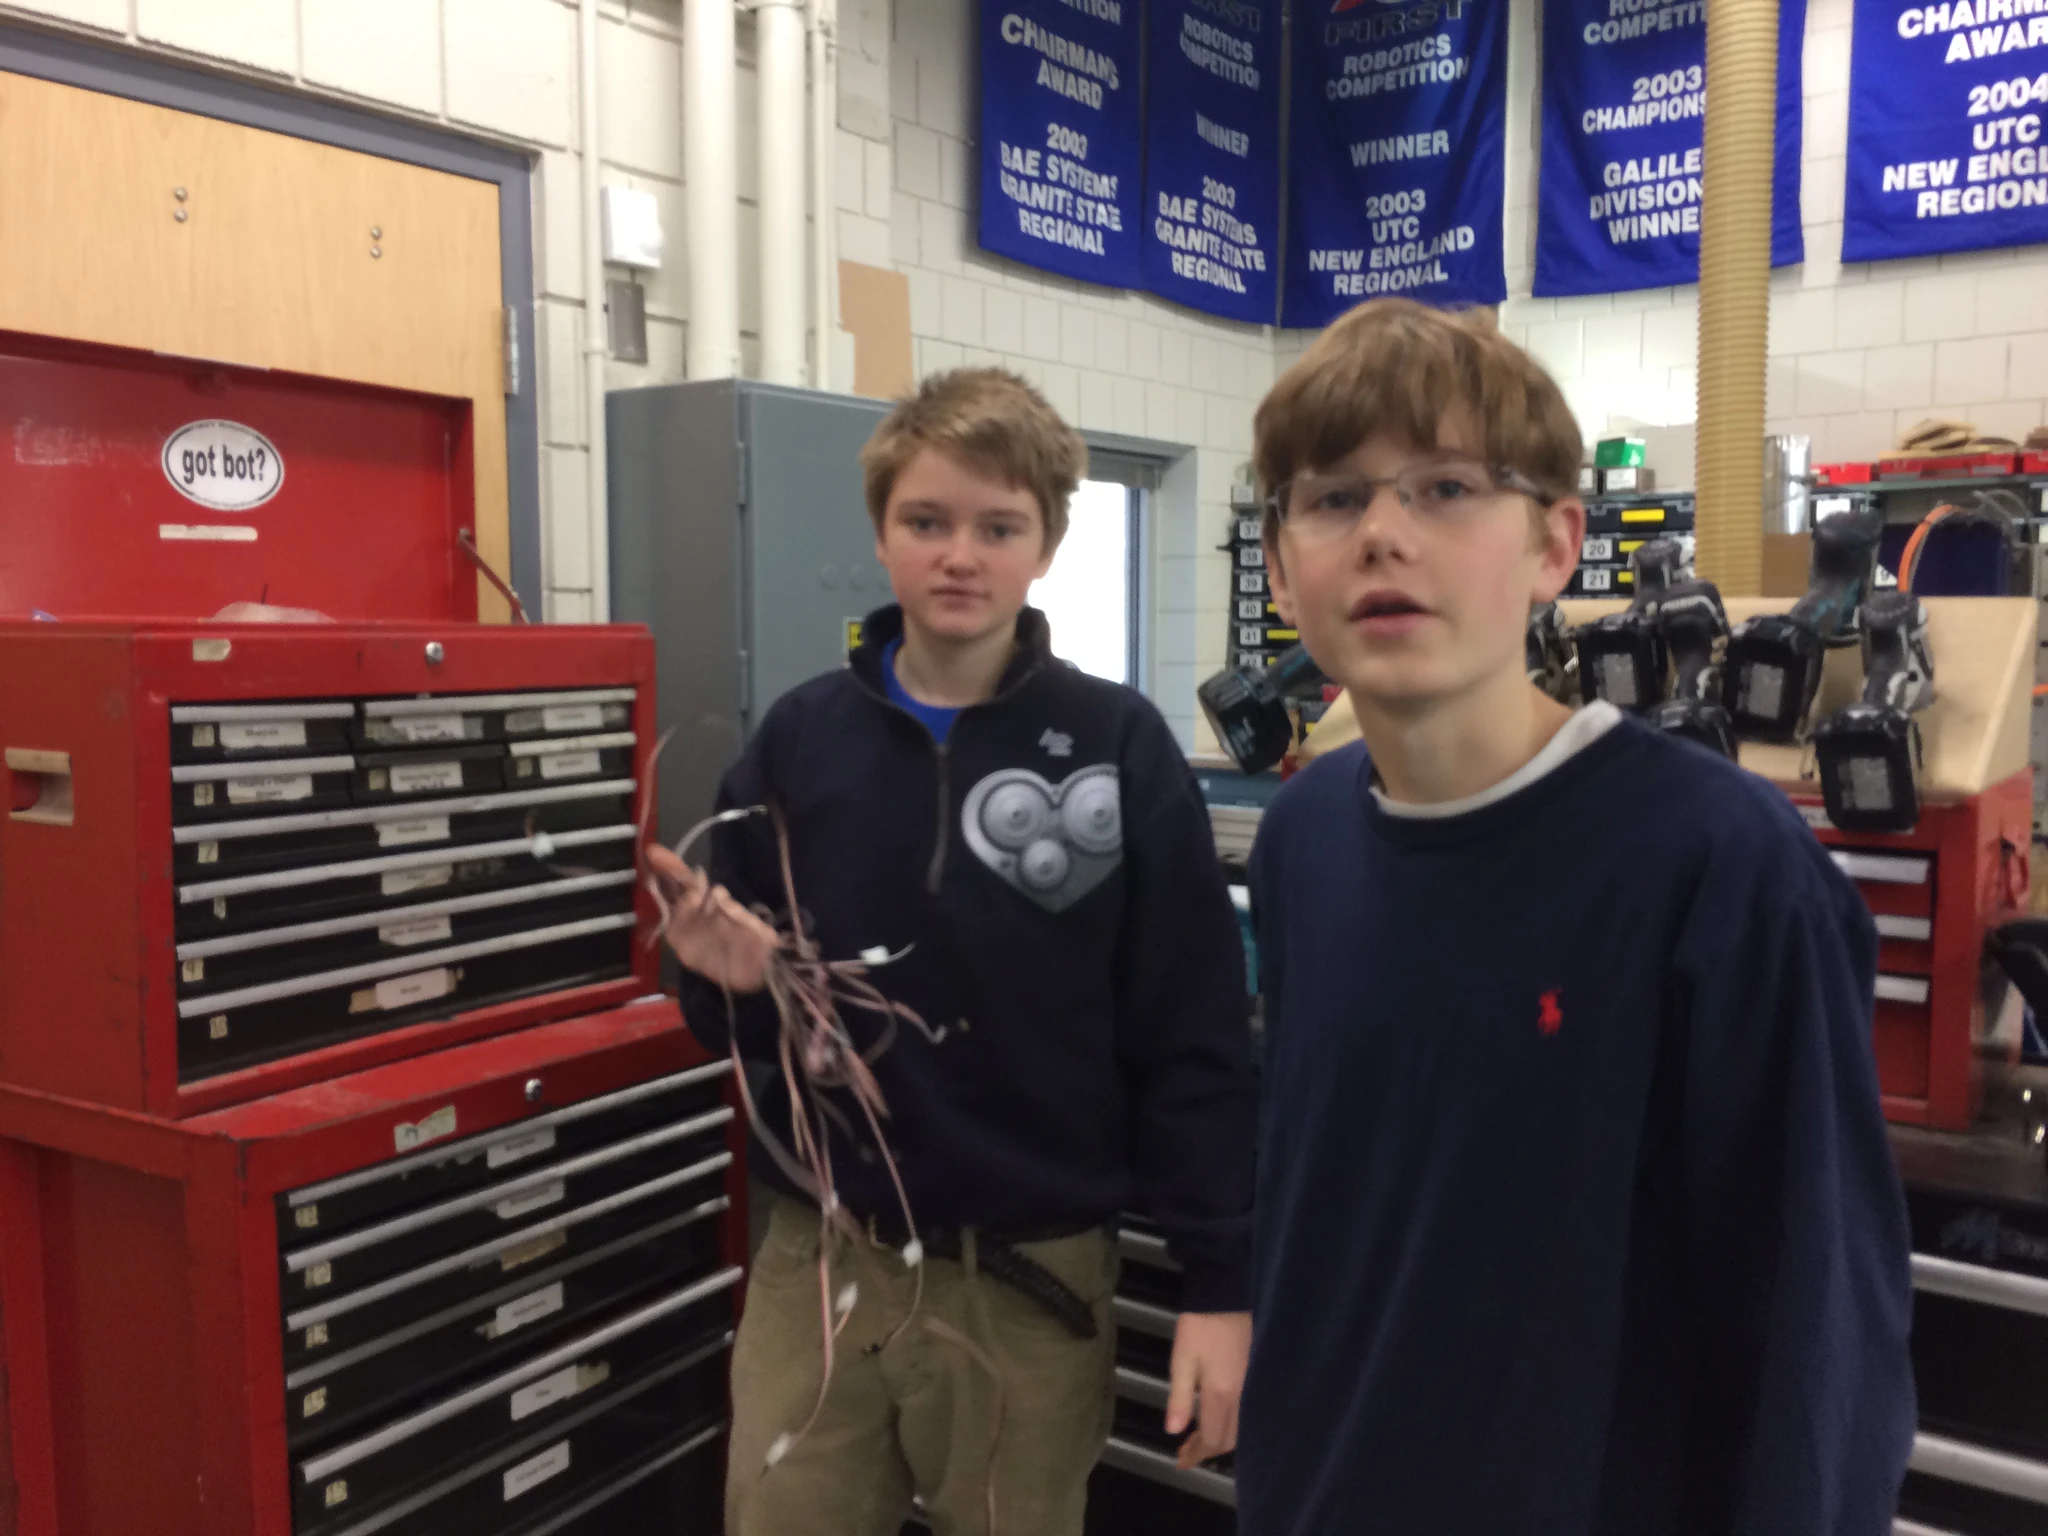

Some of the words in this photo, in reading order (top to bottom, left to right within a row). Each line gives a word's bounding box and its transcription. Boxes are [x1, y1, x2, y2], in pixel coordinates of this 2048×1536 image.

[1184, 13, 1254, 63] ROBOTICS
[1343, 33, 1452, 77] ROBOTICS
[1036, 59, 1103, 110] AWARD
[1326, 56, 1469, 101] COMPETITION
[1631, 64, 1702, 103] 2003
[1967, 72, 2048, 118] 2004
[1046, 123, 1088, 161] 2003
[1349, 129, 1450, 167] WINNER
[1972, 113, 2041, 151] UTC
[1001, 140, 1041, 178] BAE
[1046, 154, 1118, 200] SYSTEMS
[1882, 158, 1960, 193] NEW
[1001, 169, 1074, 217] GRANITE
[1076, 202, 1123, 232] STATE
[1202, 175, 1236, 210] 2003
[1365, 188, 1427, 220] 2003
[1589, 177, 1704, 220] DIVISION
[1018, 207, 1106, 256] REGIONAL
[1158, 191, 1198, 224] BAE
[1202, 203, 1258, 246] SYSTEMS
[1371, 215, 1420, 244] UTC
[1155, 216, 1221, 256] GRANITE
[1221, 244, 1267, 272] STATE
[1308, 249, 1365, 272] NEW
[1368, 225, 1476, 269] ENGLAND
[1171, 251, 1248, 294] REGIONAL
[1333, 259, 1449, 296] REGIONAL
[182, 444, 217, 485] got
[222, 444, 266, 482] bot?
[1589, 544, 1606, 556] 20
[1588, 574, 1605, 586] 21
[1243, 603, 1257, 614] 40
[1243, 630, 1257, 641] 41
